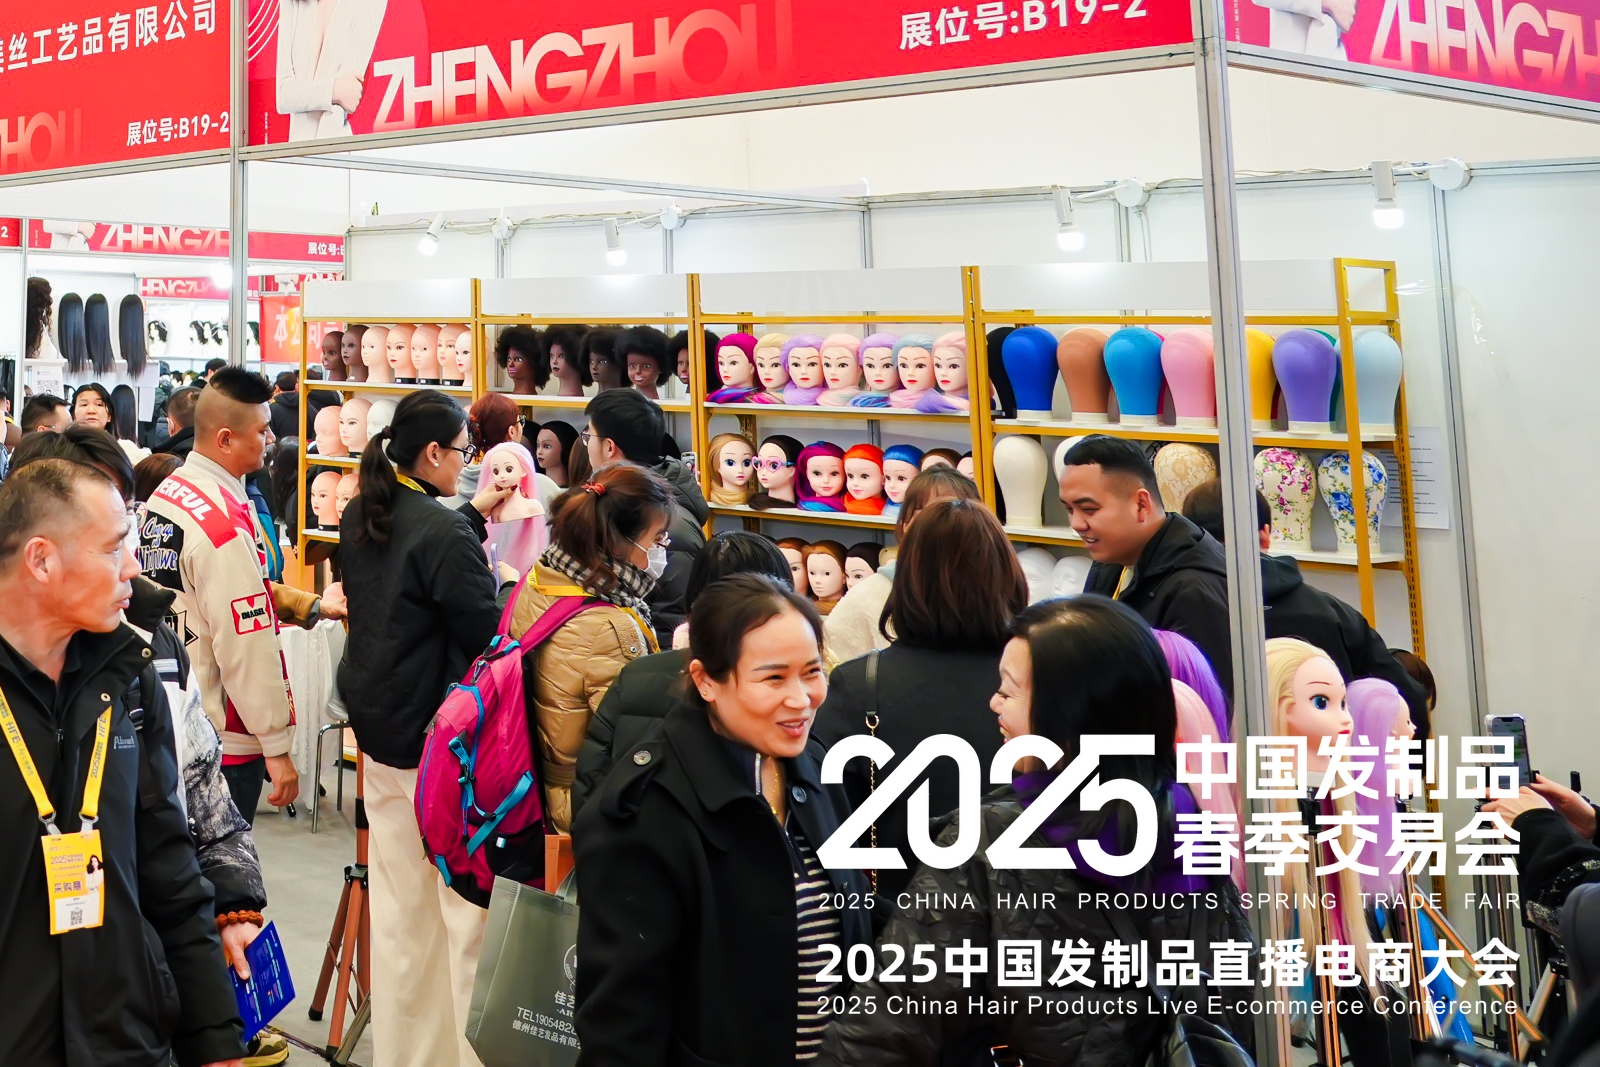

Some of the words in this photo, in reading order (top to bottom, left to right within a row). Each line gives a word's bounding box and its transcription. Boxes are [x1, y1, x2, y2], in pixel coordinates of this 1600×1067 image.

[127, 111, 230, 147] 展位号:B19-2
[156, 478, 213, 521] ERFUL
[6, 721, 21, 744] HFE
